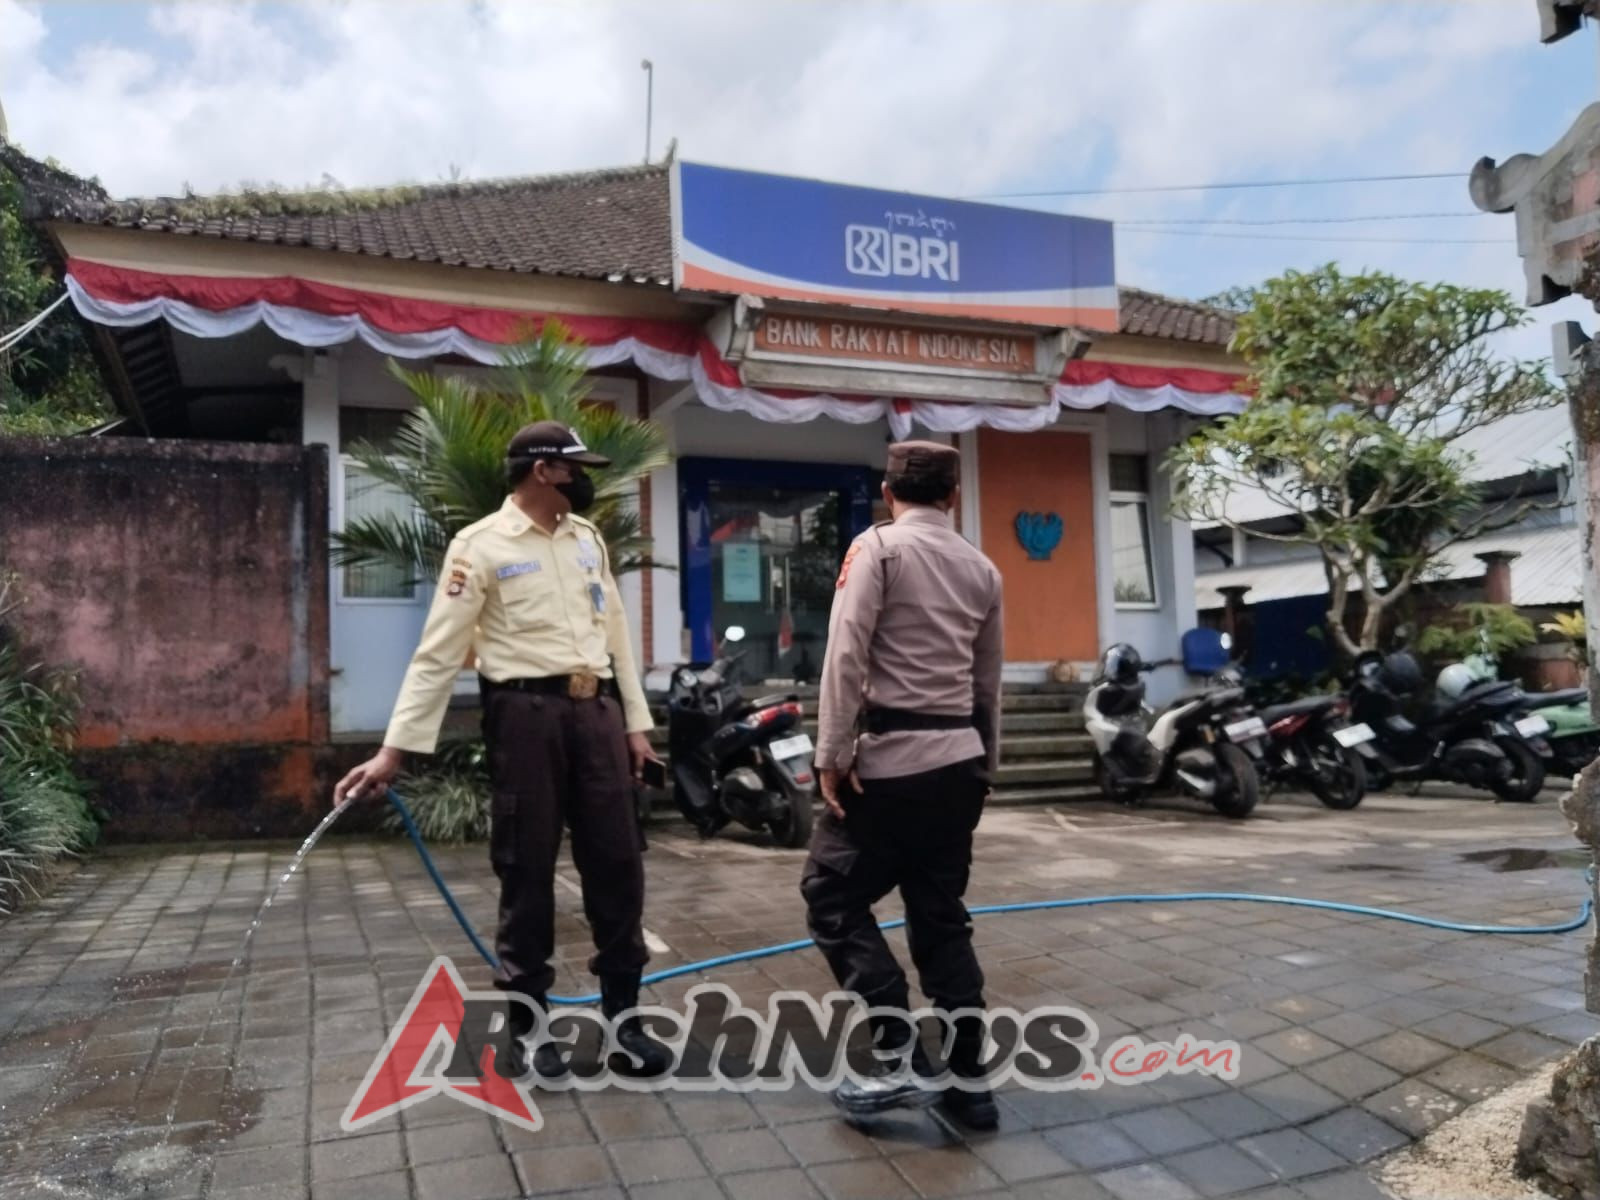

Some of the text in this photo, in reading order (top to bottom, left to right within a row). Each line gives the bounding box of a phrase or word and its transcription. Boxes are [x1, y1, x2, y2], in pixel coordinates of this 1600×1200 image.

[892, 233, 959, 282] BRI
[766, 319, 1020, 364] BANK RAKYAT INDONESIA
